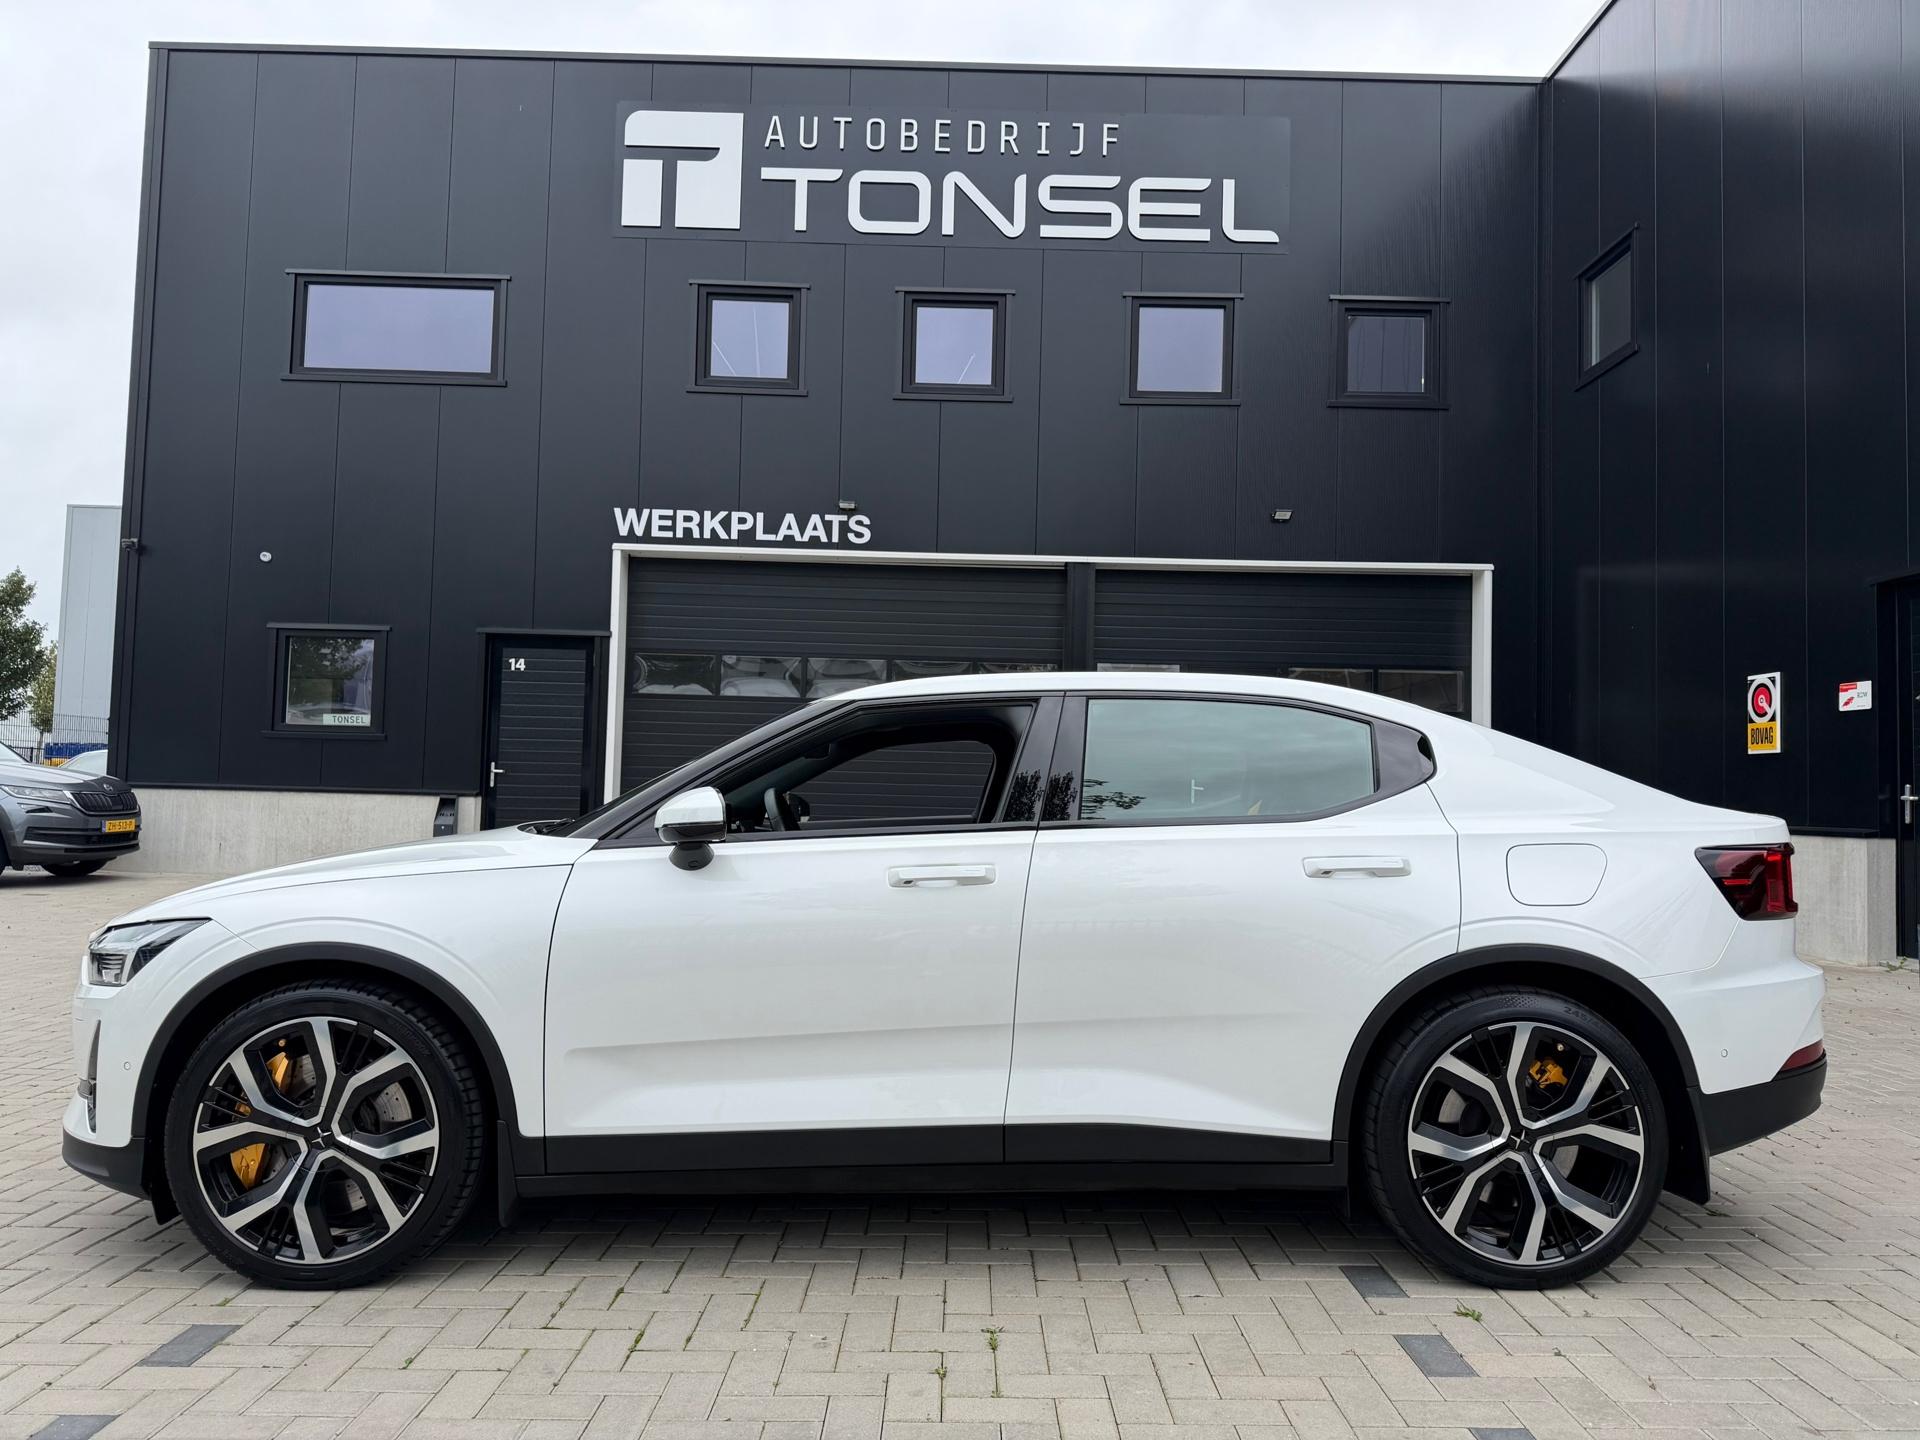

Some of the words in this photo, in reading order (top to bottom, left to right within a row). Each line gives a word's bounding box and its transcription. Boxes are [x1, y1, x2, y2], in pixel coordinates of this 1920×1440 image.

[764, 115, 1119, 156] AUTOBEDRIJF
[761, 166, 1280, 243] TONSEL
[613, 507, 872, 544] WERKPLAATS
[507, 657, 526, 672] 14
[332, 715, 367, 724] TONSEL
[1750, 727, 1774, 745] BOVAG
